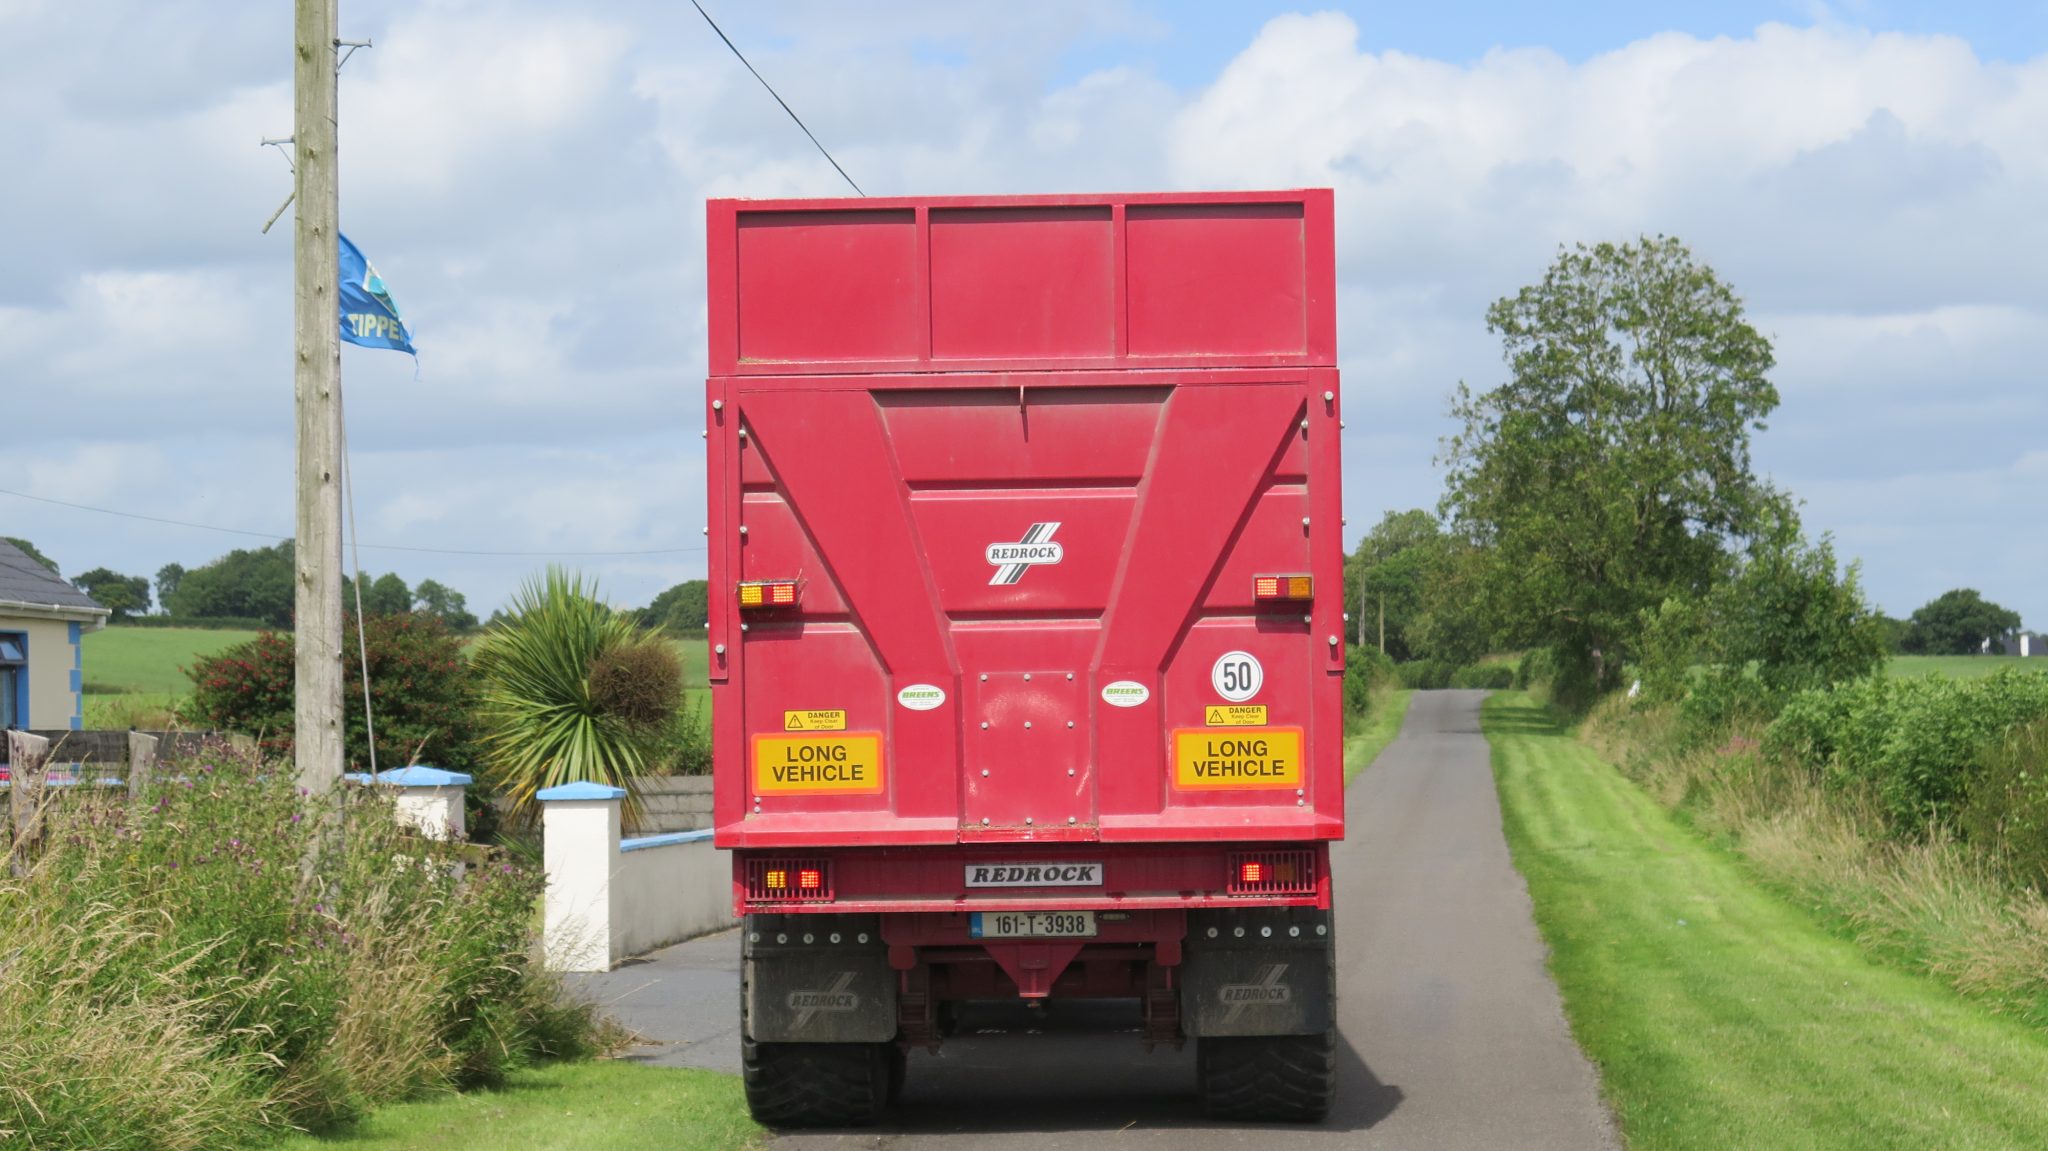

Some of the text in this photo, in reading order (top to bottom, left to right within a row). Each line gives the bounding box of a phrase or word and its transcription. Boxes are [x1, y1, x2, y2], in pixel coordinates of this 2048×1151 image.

[347, 313, 403, 341] TIPPE
[991, 547, 1057, 560] REDROCK
[1223, 661, 1252, 692] 50
[902, 691, 940, 699] BREENS
[807, 711, 841, 719] DANGER
[1229, 706, 1262, 714] DANGER
[786, 745, 847, 763] LONG
[1207, 740, 1268, 758] LONG
[772, 764, 864, 782] VEHICLE
[1193, 759, 1285, 777] VEHICLE
[972, 866, 1095, 883] REDROCK
[995, 915, 1086, 934] 161-T-3938
[791, 994, 854, 1007] REDROCK
[1223, 987, 1287, 1001] REDROCK
